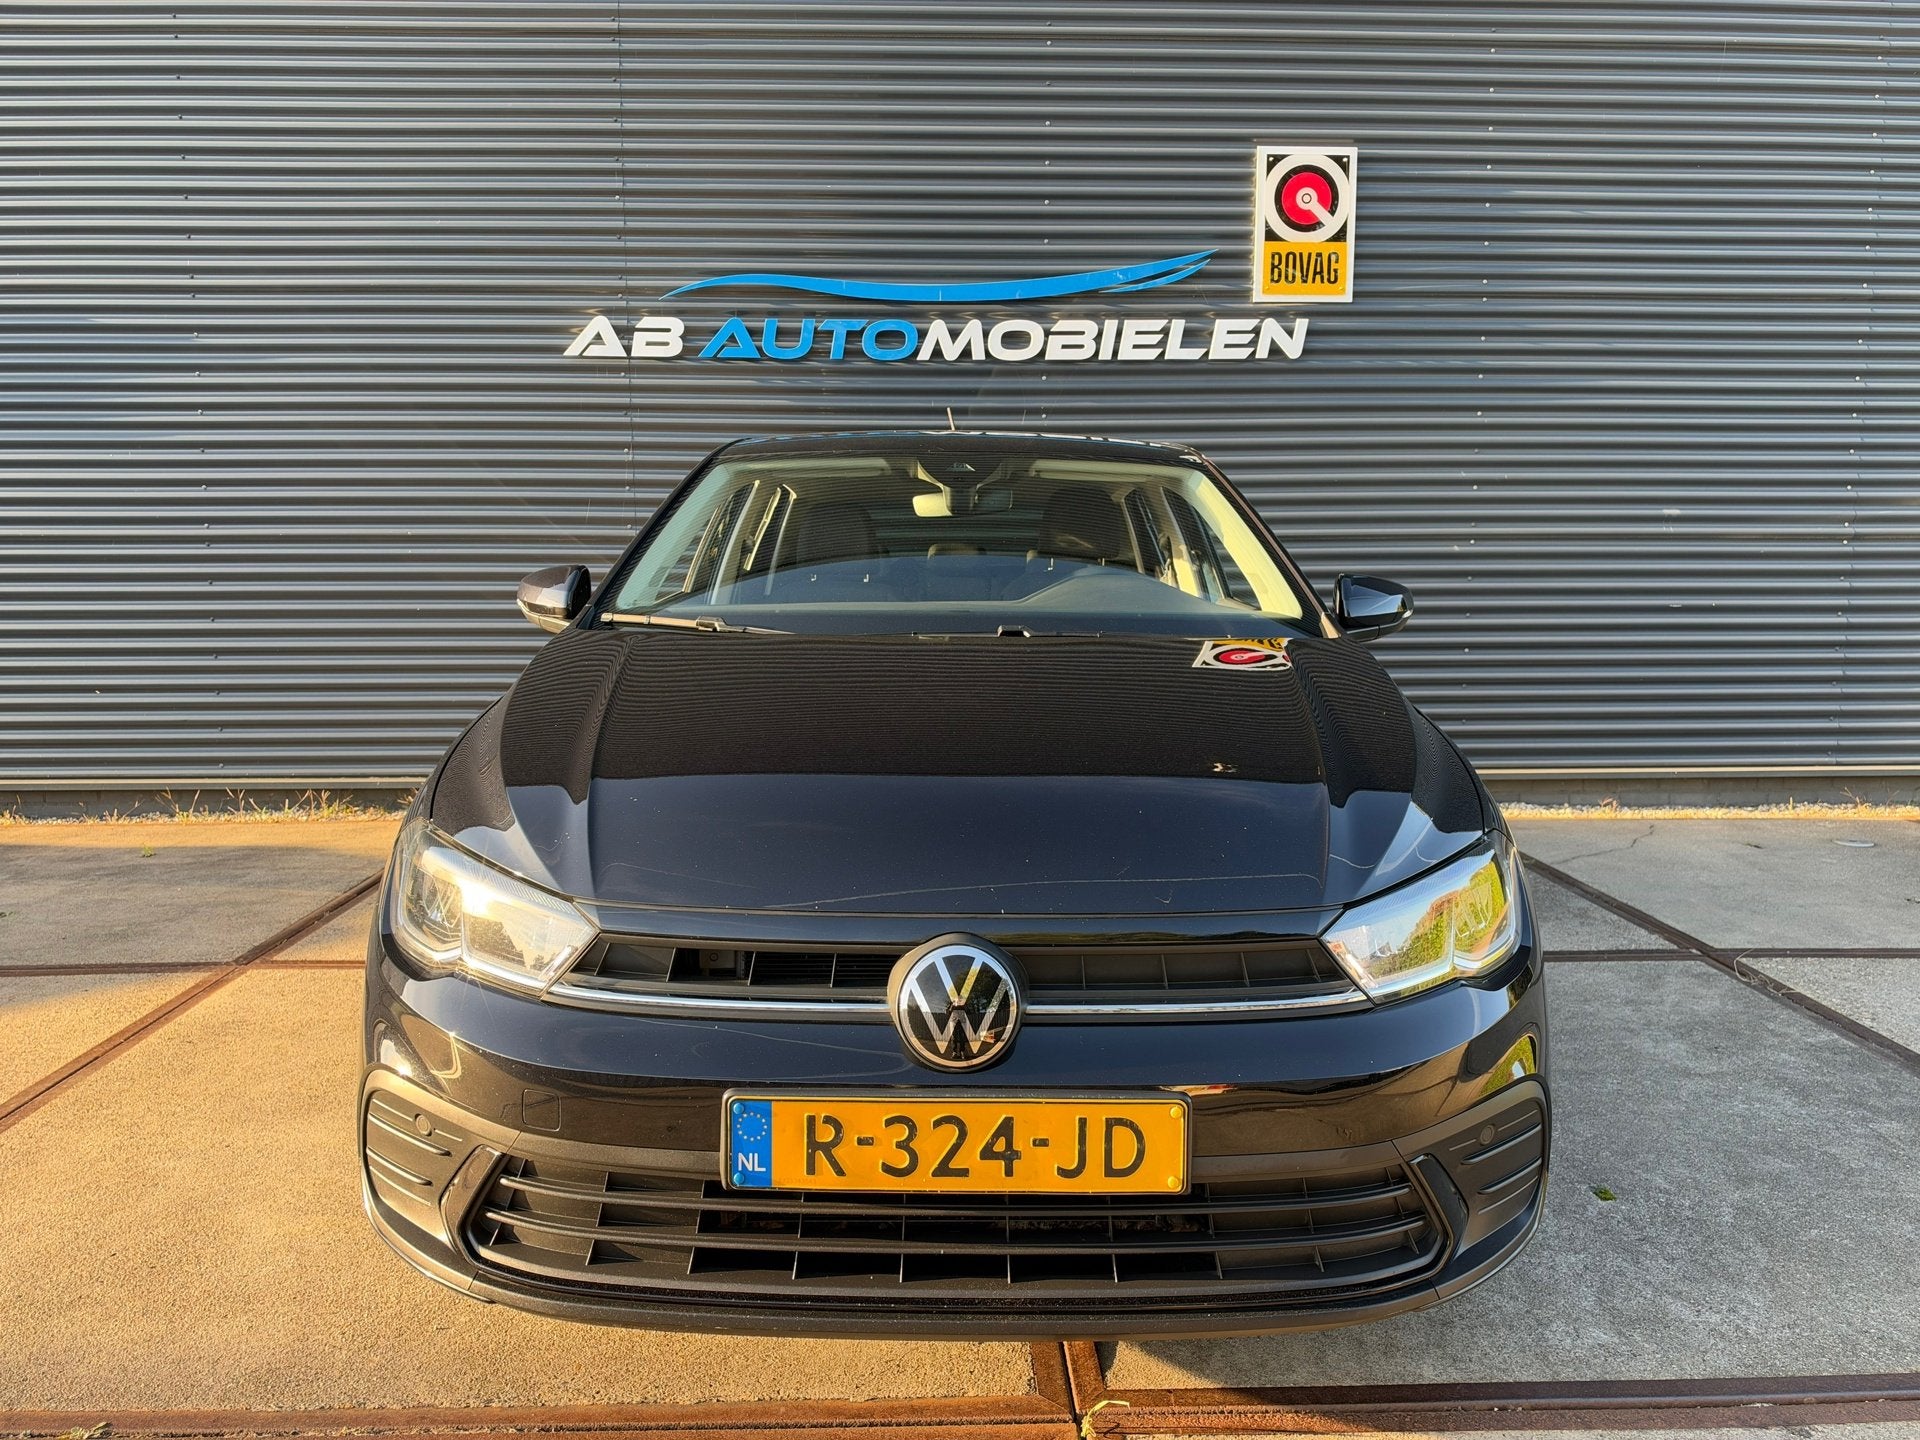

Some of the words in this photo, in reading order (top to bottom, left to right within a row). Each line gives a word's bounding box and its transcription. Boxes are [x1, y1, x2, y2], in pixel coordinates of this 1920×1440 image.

[1270, 251, 1339, 285] BOVAG
[563, 315, 685, 357] AB
[697, 317, 1309, 361] AUTOMOBIELEN
[737, 1152, 766, 1172] NL
[804, 1113, 1146, 1179] R-324-JD
